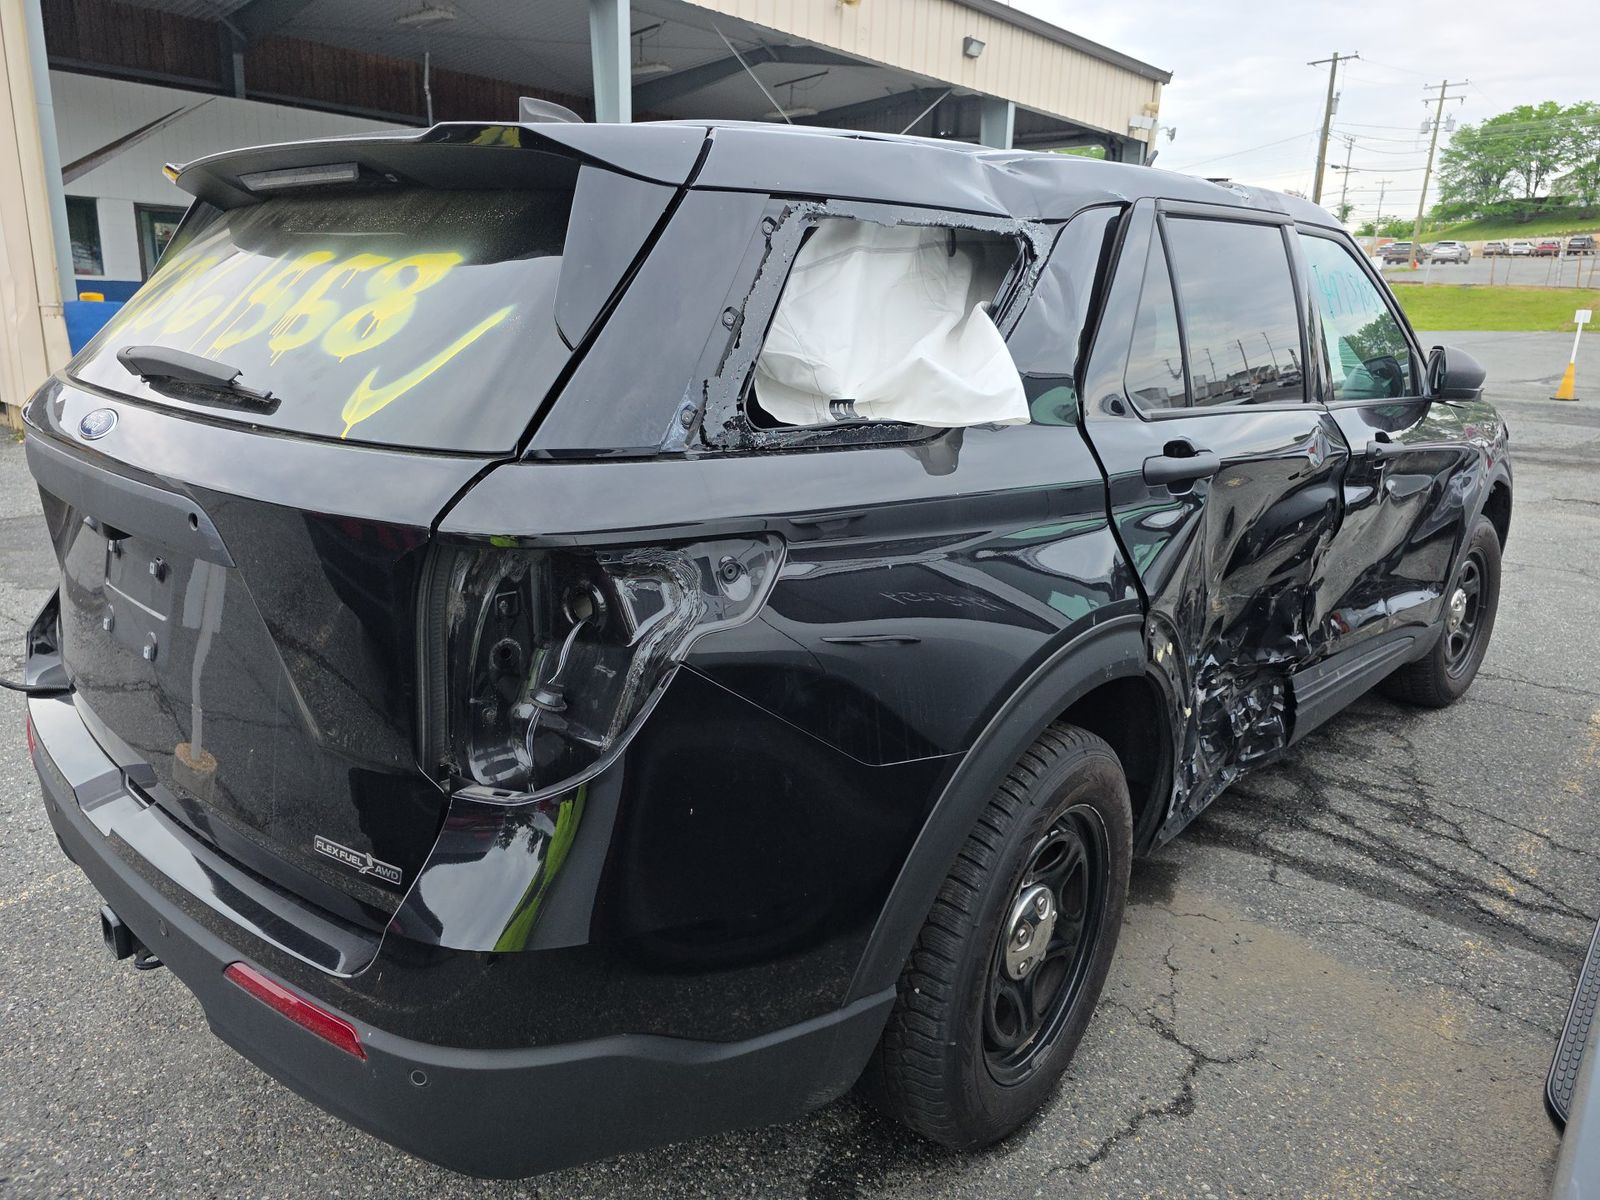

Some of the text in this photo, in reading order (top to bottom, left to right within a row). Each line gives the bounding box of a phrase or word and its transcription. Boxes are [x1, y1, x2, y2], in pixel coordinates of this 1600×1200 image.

[316, 840, 399, 880] FLEX FUEL AWD
